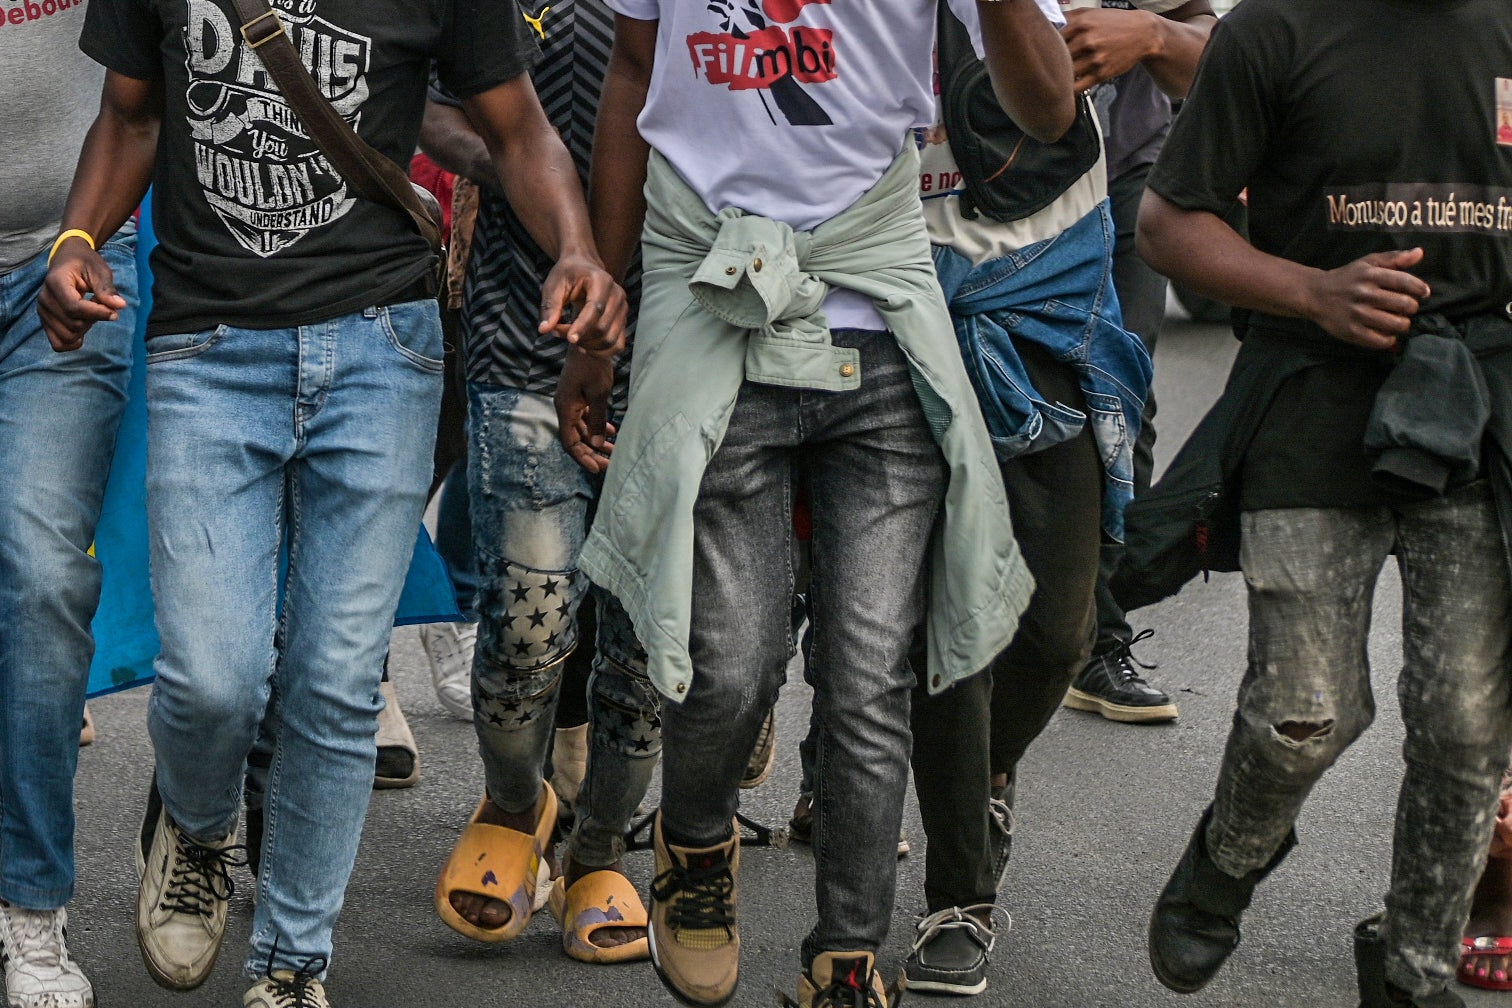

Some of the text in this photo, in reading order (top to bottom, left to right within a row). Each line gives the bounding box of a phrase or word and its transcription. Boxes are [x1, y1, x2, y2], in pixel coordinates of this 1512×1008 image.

[693, 30, 831, 79] Filimbi
[258, 99, 306, 132] THIN
[248, 129, 289, 158] You
[250, 196, 334, 228] UNDERSTAND
[1326, 194, 1408, 226] Monusco
[1410, 200, 1423, 226] a
[1426, 192, 1456, 227] tué
[1459, 200, 1494, 229] mes
